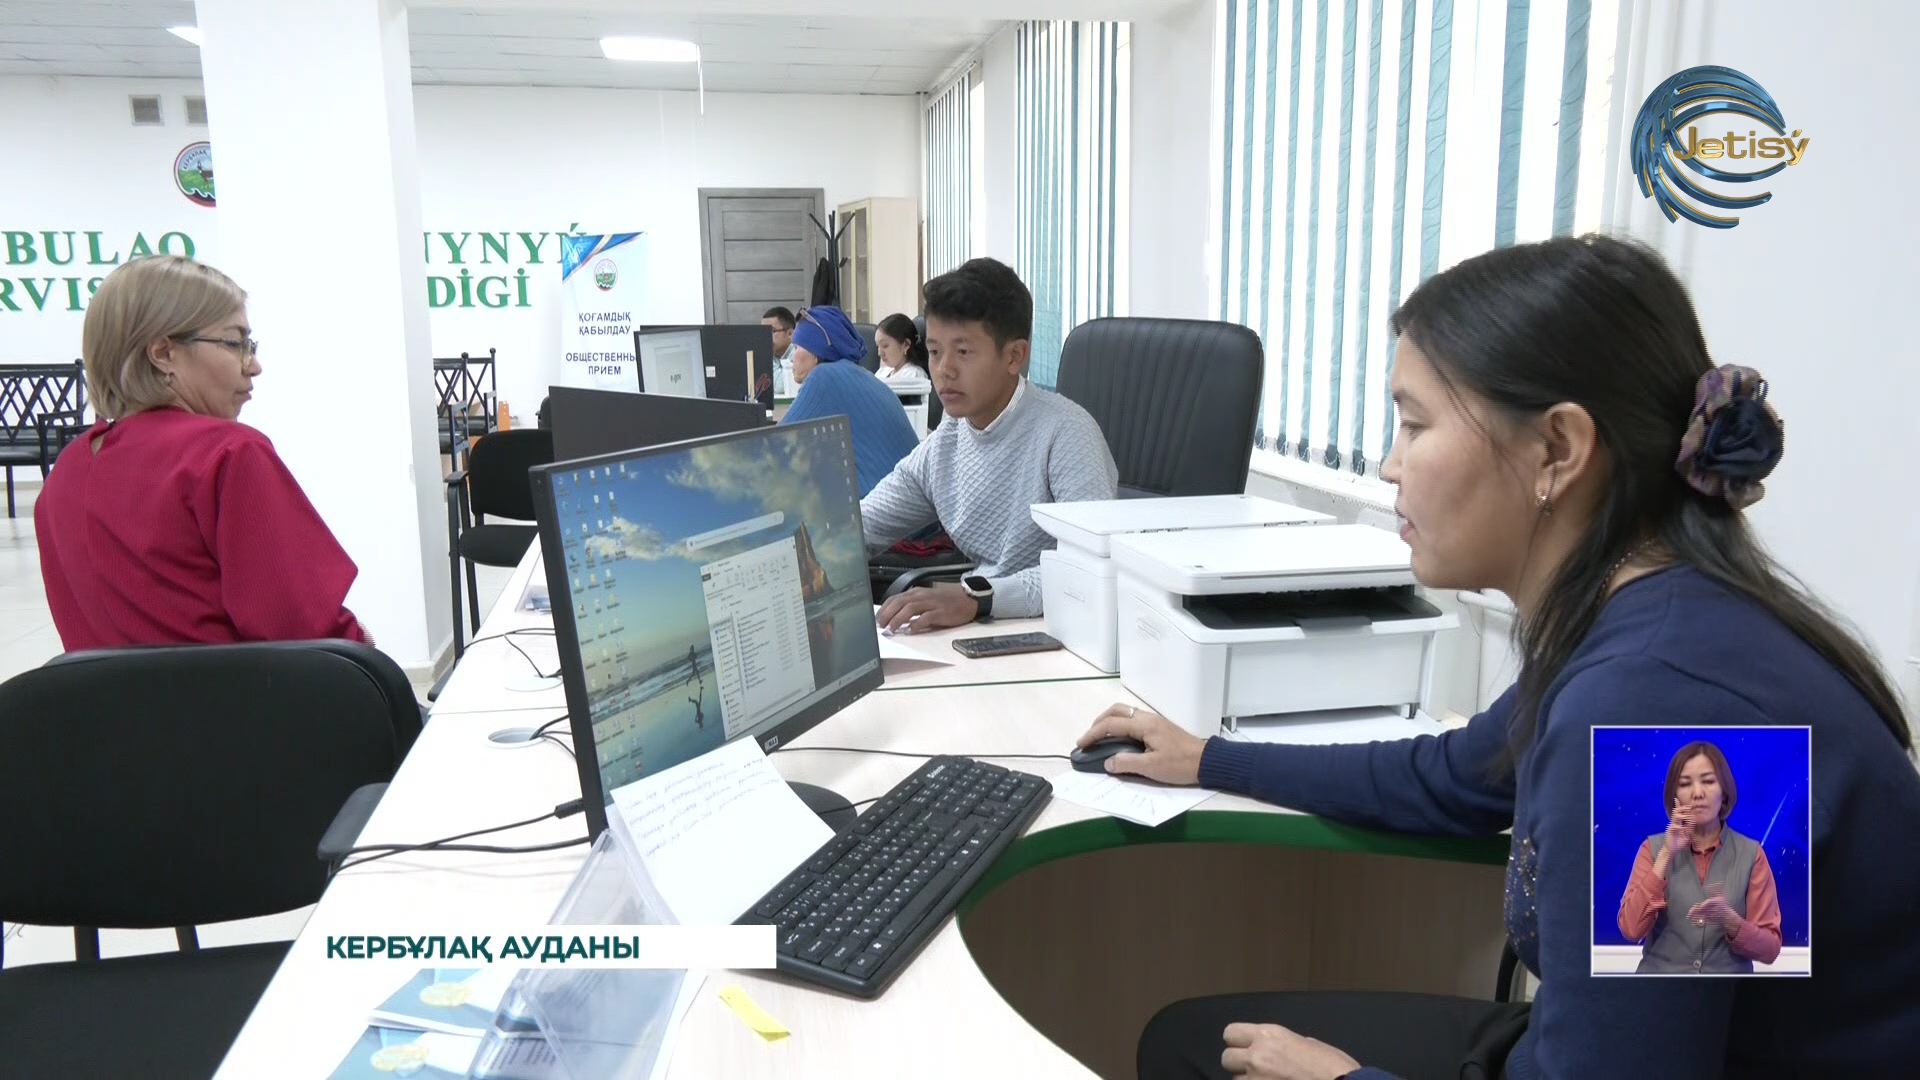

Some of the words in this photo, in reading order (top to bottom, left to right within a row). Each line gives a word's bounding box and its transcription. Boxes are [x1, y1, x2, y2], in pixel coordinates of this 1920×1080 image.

[578, 311, 632, 323] ҚОҒАМДЫҚ
[578, 325, 631, 336] ҚАБЫЛДАУ
[588, 365, 622, 375] ПРИЕМ
